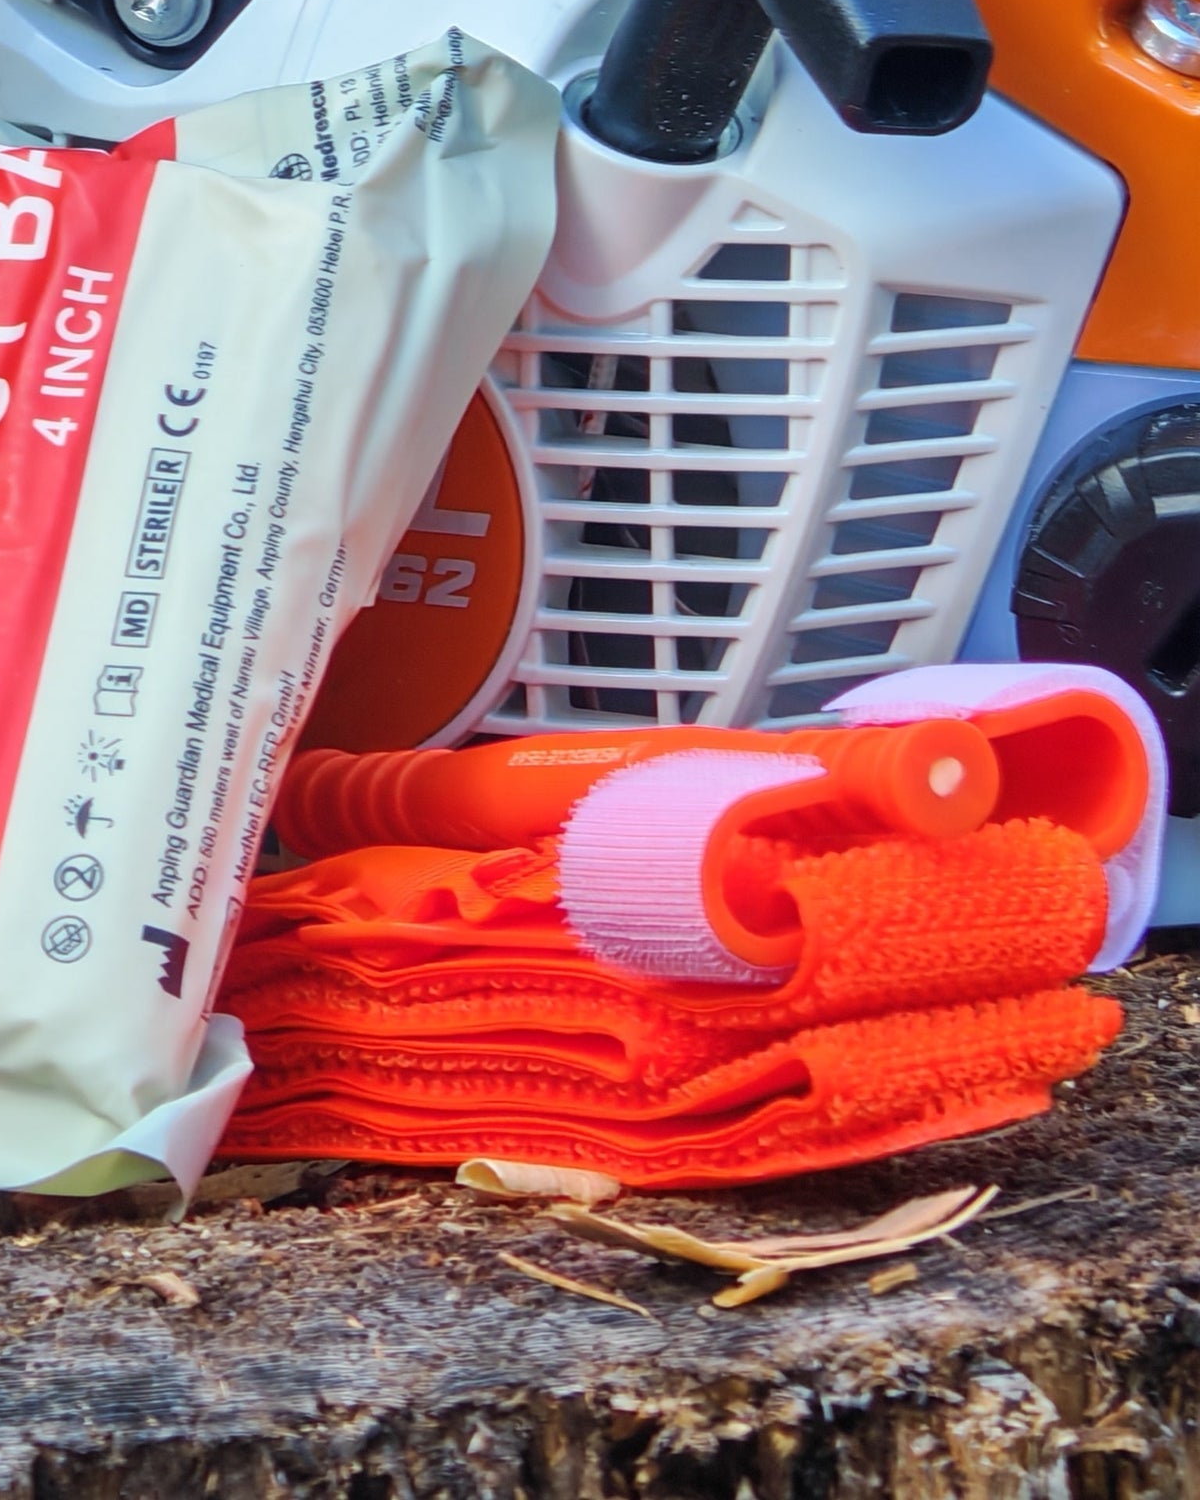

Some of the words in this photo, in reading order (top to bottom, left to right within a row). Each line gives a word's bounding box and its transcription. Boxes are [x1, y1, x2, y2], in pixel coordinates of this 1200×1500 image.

[318, 226, 346, 275] Hebei
[39, 265, 115, 398] INCH
[306, 277, 335, 337] 053600
[192, 341, 218, 380] 0197
[298, 341, 327, 376] City,
[32, 416, 79, 447] 4
[282, 378, 315, 454] Hengshui
[155, 457, 183, 475] R
[232, 461, 262, 496] Ltd.
[267, 458, 302, 519] County,
[135, 480, 178, 572] STERILE
[222, 500, 256, 540] Co.,
[256, 520, 287, 582] Anping
[120, 599, 151, 639] MD
[201, 544, 243, 651] Equipment
[242, 584, 274, 642] Village,
[185, 652, 222, 735] Medical
[232, 646, 257, 701] Nansu
[270, 670, 297, 729] GmbH
[229, 698, 246, 722] of
[221, 721, 241, 763] west
[165, 735, 203, 831] Guardian
[210, 764, 233, 824] meters
[151, 828, 188, 909] Anping
[186, 861, 210, 921] ADD:
